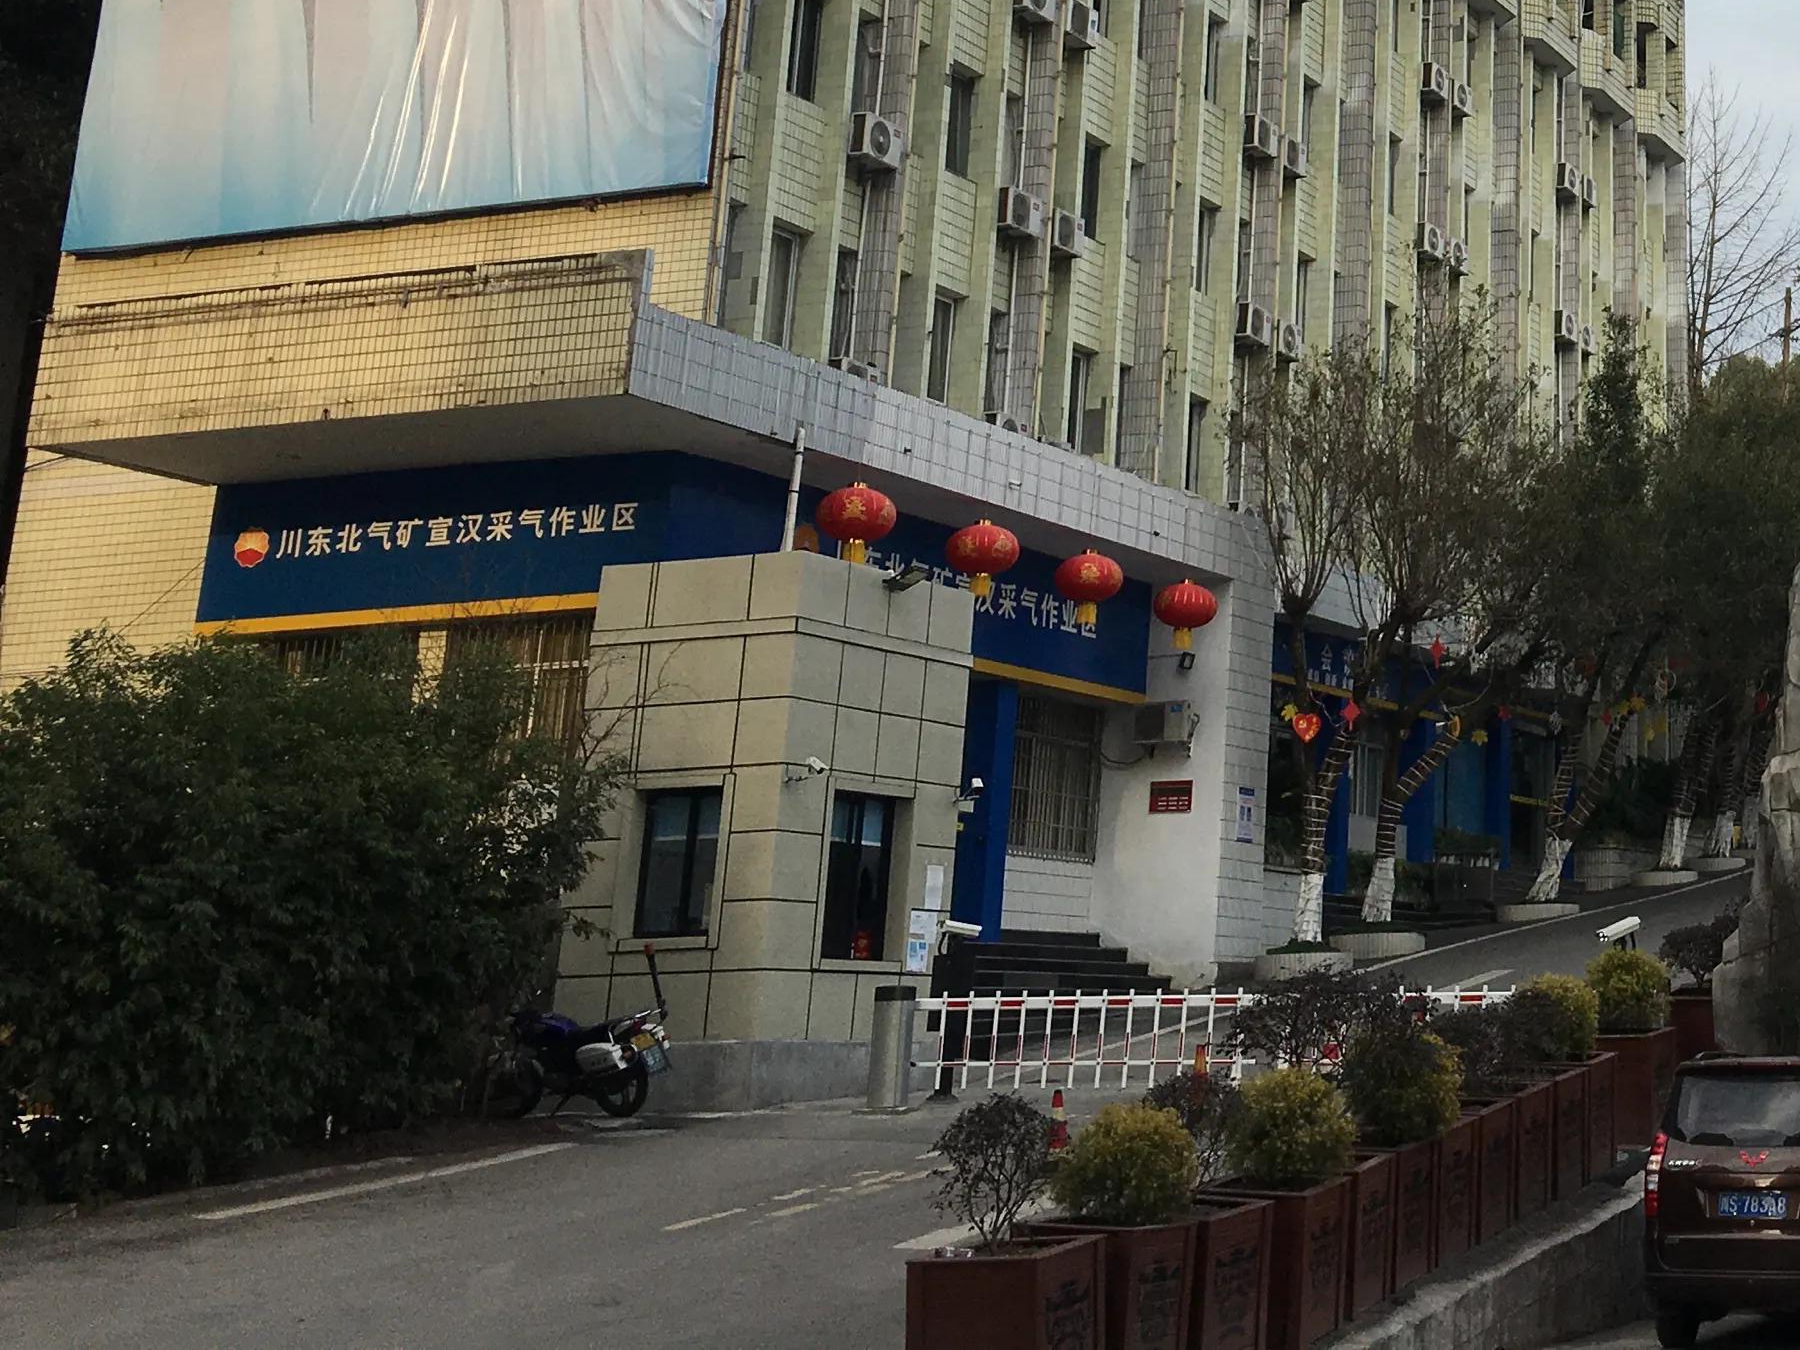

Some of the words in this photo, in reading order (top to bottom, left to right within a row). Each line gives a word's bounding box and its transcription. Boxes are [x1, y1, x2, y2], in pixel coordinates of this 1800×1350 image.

[275, 502, 639, 559] 川东北气矿宣汉采气作业区
